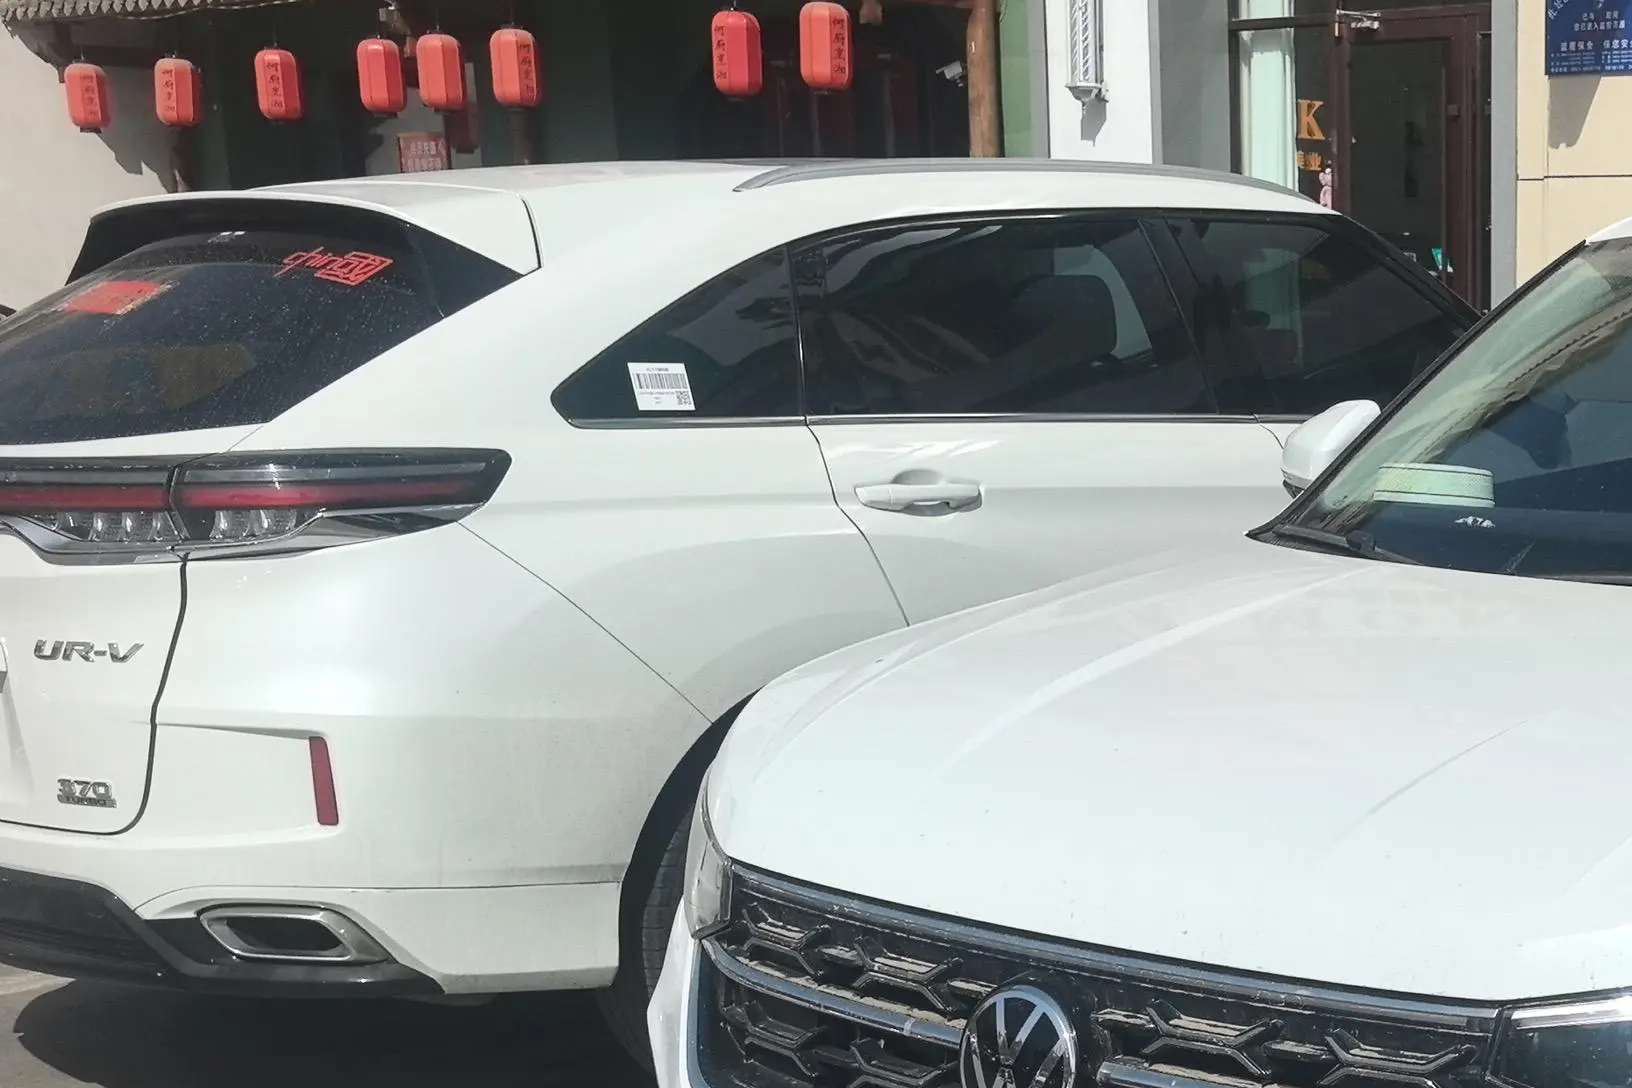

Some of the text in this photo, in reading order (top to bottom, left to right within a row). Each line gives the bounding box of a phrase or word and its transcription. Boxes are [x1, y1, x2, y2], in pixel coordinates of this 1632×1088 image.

[1297, 99, 1326, 141] K
[33, 638, 145, 664] UR-V
[57, 778, 113, 801] 370
